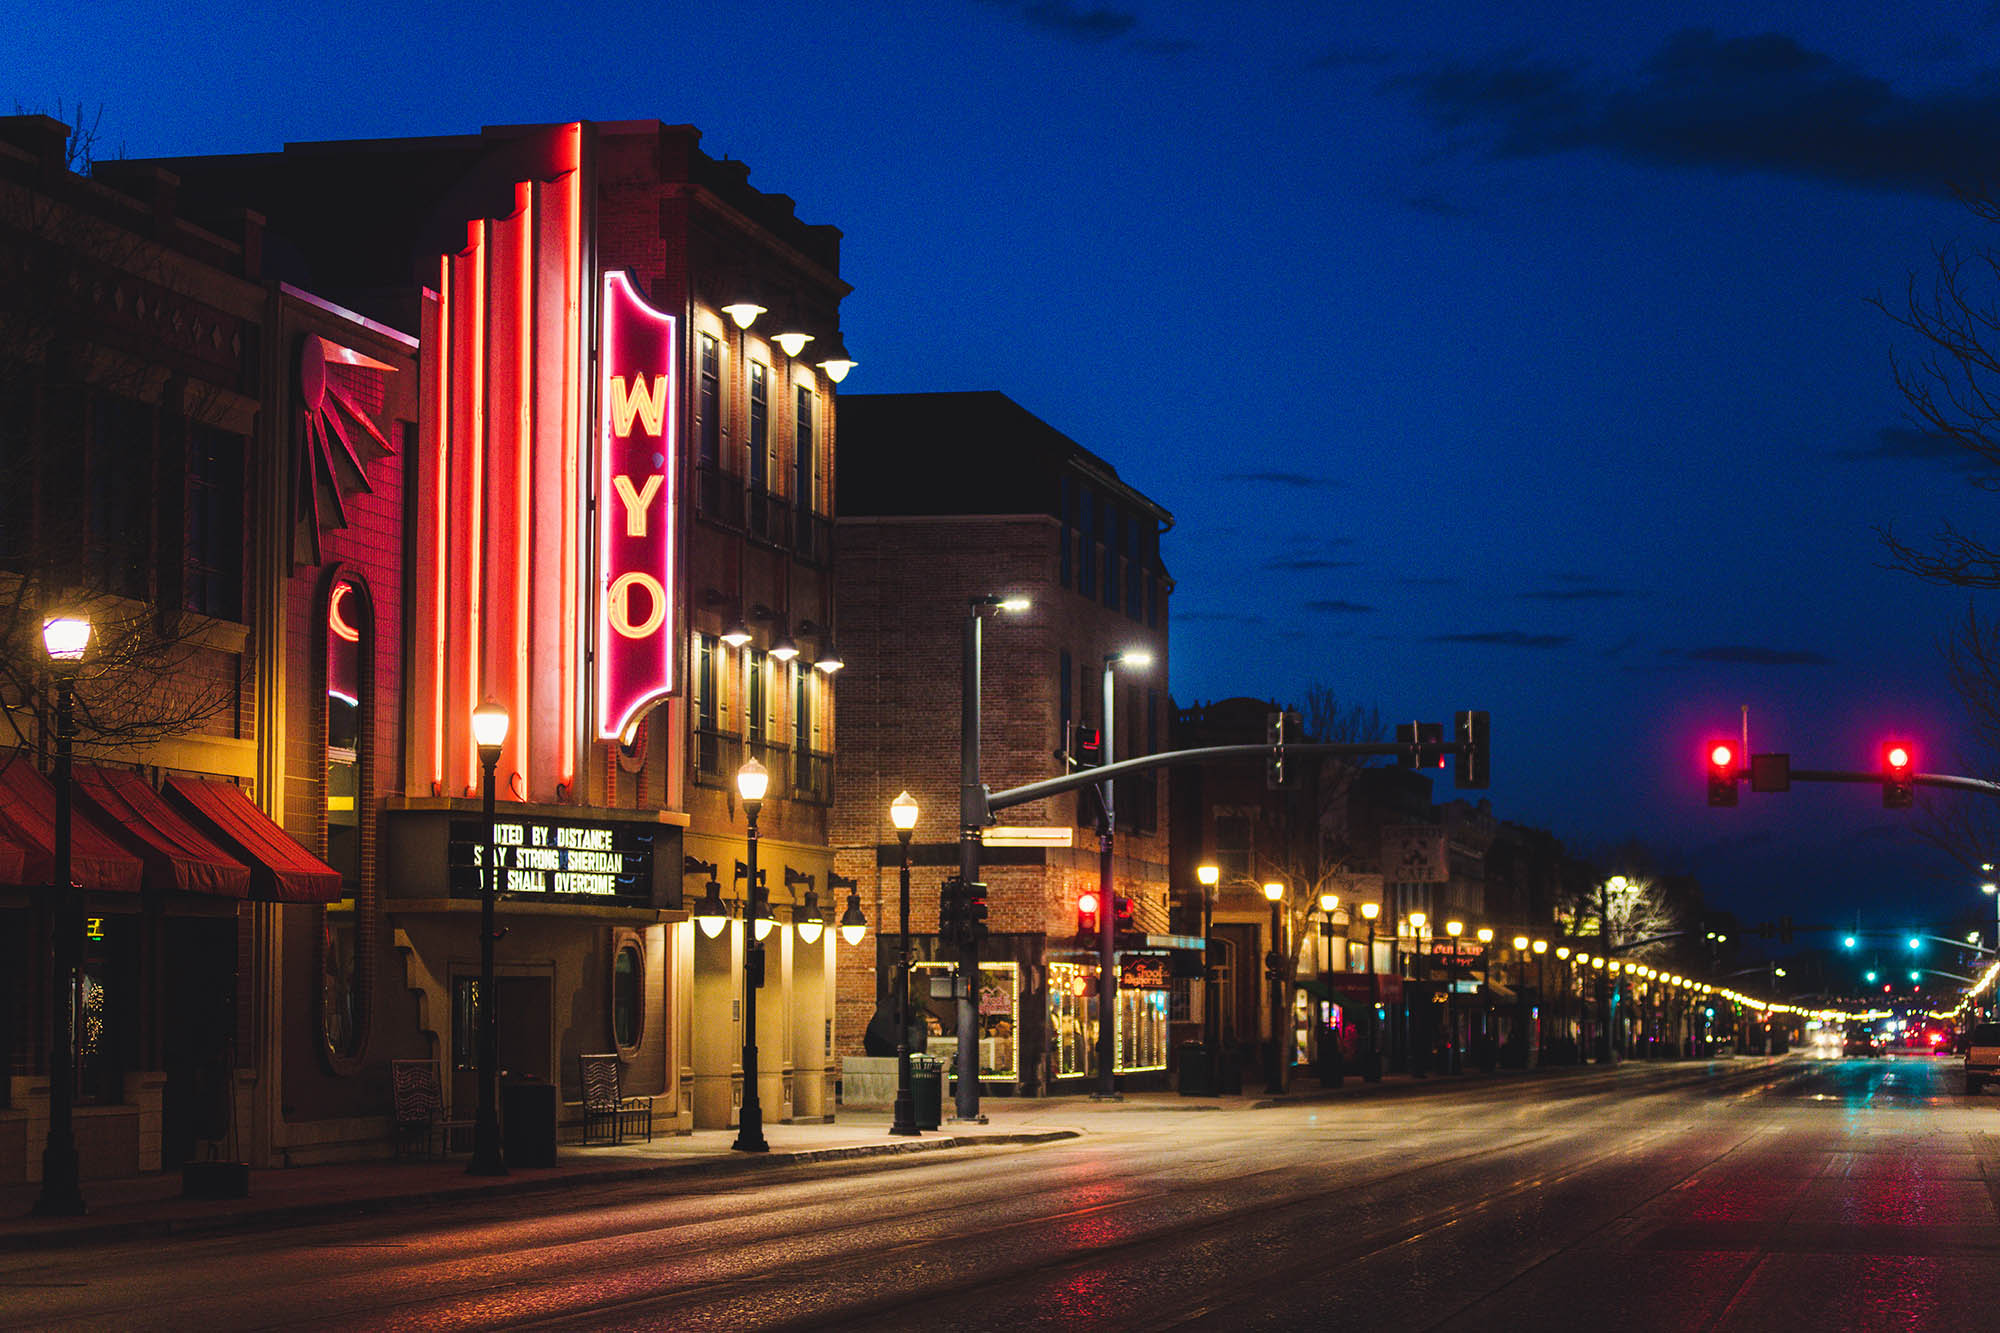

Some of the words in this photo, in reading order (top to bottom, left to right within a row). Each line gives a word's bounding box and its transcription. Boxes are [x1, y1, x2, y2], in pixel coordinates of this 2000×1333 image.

[609, 371, 668, 640] WYO
[532, 826, 549, 846] BY
[558, 828, 613, 850] DISTANCE
[516, 848, 560, 869] STRONG
[567, 851, 623, 873] SHERIDAN
[507, 870, 546, 892] SHALL
[554, 873, 616, 895] OVERCOME
